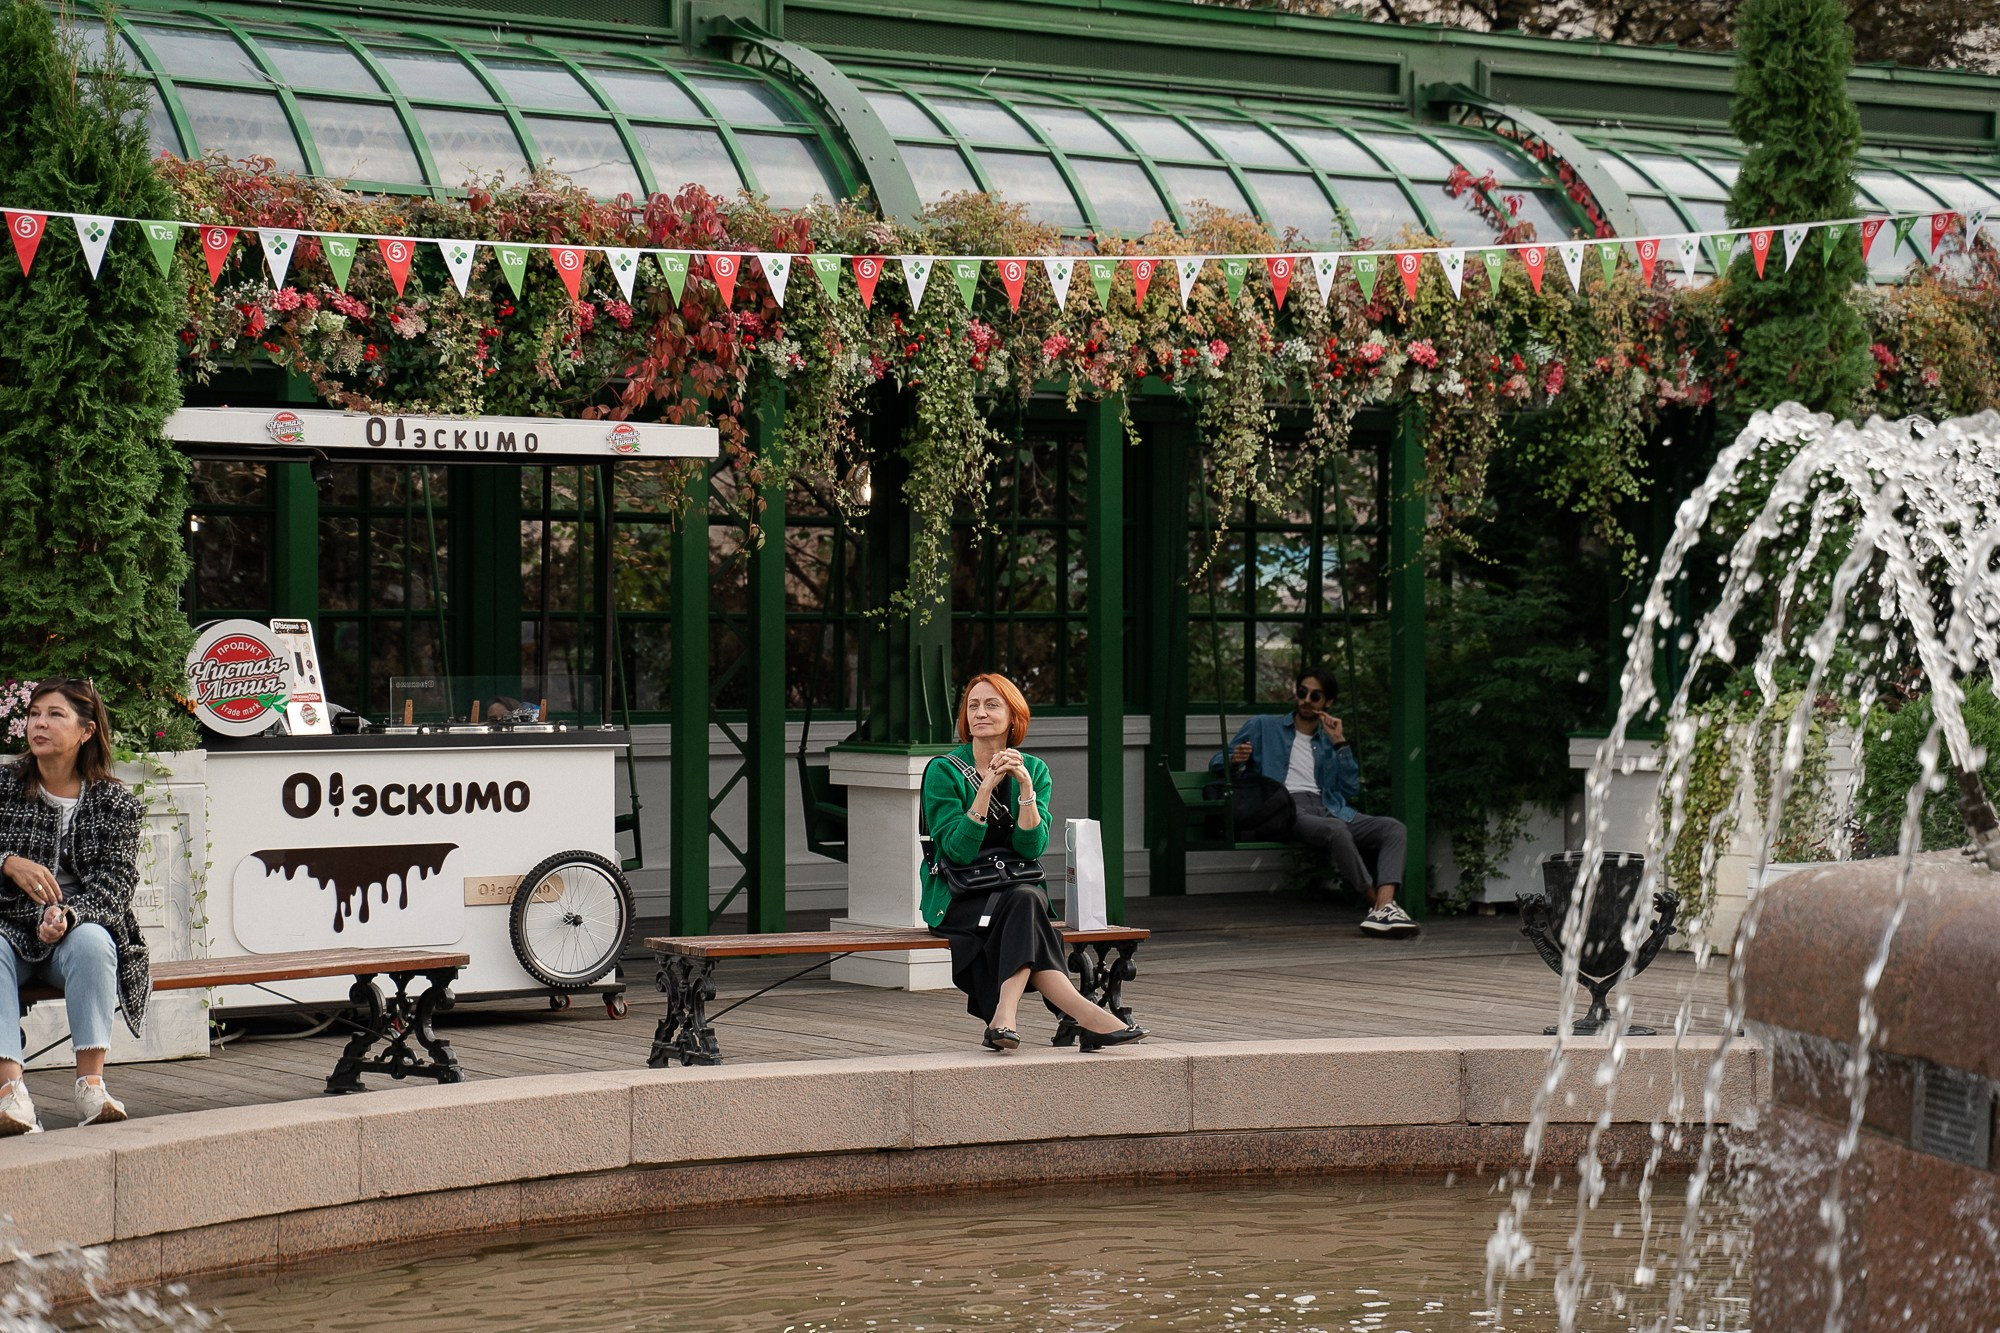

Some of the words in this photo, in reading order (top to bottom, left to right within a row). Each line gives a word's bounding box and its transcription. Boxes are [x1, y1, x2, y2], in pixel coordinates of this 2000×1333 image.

[158, 230, 173, 240] X5
[338, 248, 351, 257] X5
[510, 257, 523, 265] X5
[672, 263, 684, 272] X5
[825, 263, 837, 271] X5
[965, 270, 975, 278] X5
[1100, 270, 1110, 278] X5
[217, 641, 263, 656] ПРОДУКТ
[188, 657, 290, 682] Чистая
[197, 677, 286, 704] Линия
[221, 704, 241, 717] trade
[242, 703, 261, 716] mark
